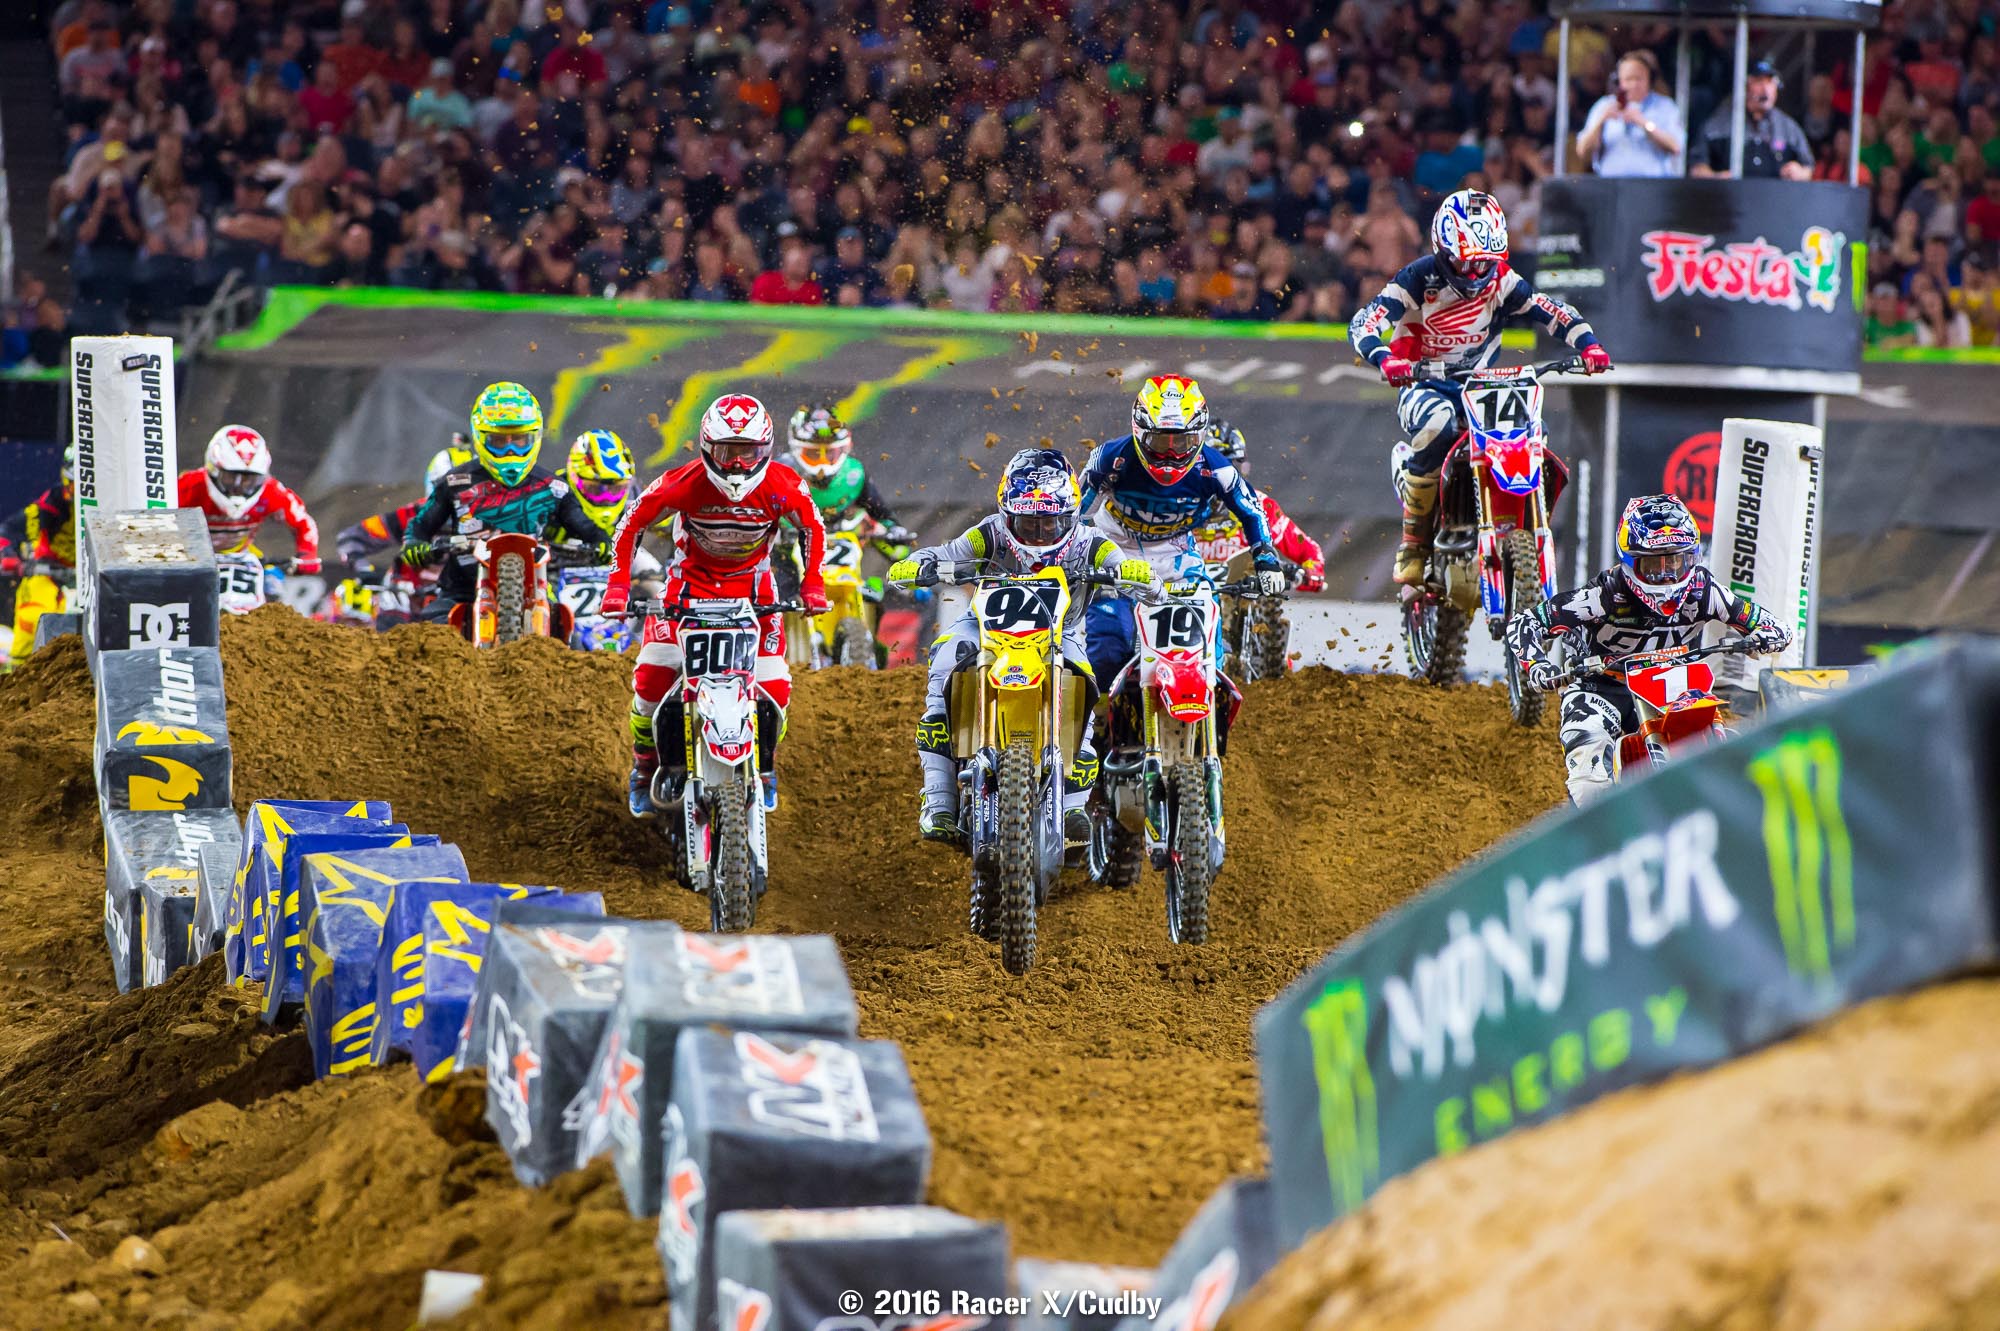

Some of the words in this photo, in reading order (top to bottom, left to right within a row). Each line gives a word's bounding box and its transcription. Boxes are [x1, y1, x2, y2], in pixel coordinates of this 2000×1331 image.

[1642, 231, 1801, 310] Fiesta
[1423, 332, 1485, 347] HOND
[1475, 390, 1529, 432] 14
[1013, 503, 1036, 512] Red
[1037, 502, 1060, 512] Bull
[574, 586, 602, 618] 2
[984, 587, 1061, 632] 94
[129, 603, 190, 650] DC
[1149, 606, 1206, 649] 19
[1652, 665, 1689, 705] 1
[1171, 703, 1208, 712] GEICO
[1046, 786, 1054, 820] ACERBIS
[687, 801, 696, 859] DUNLOP
[1384, 808, 1739, 1079] MONSTER
